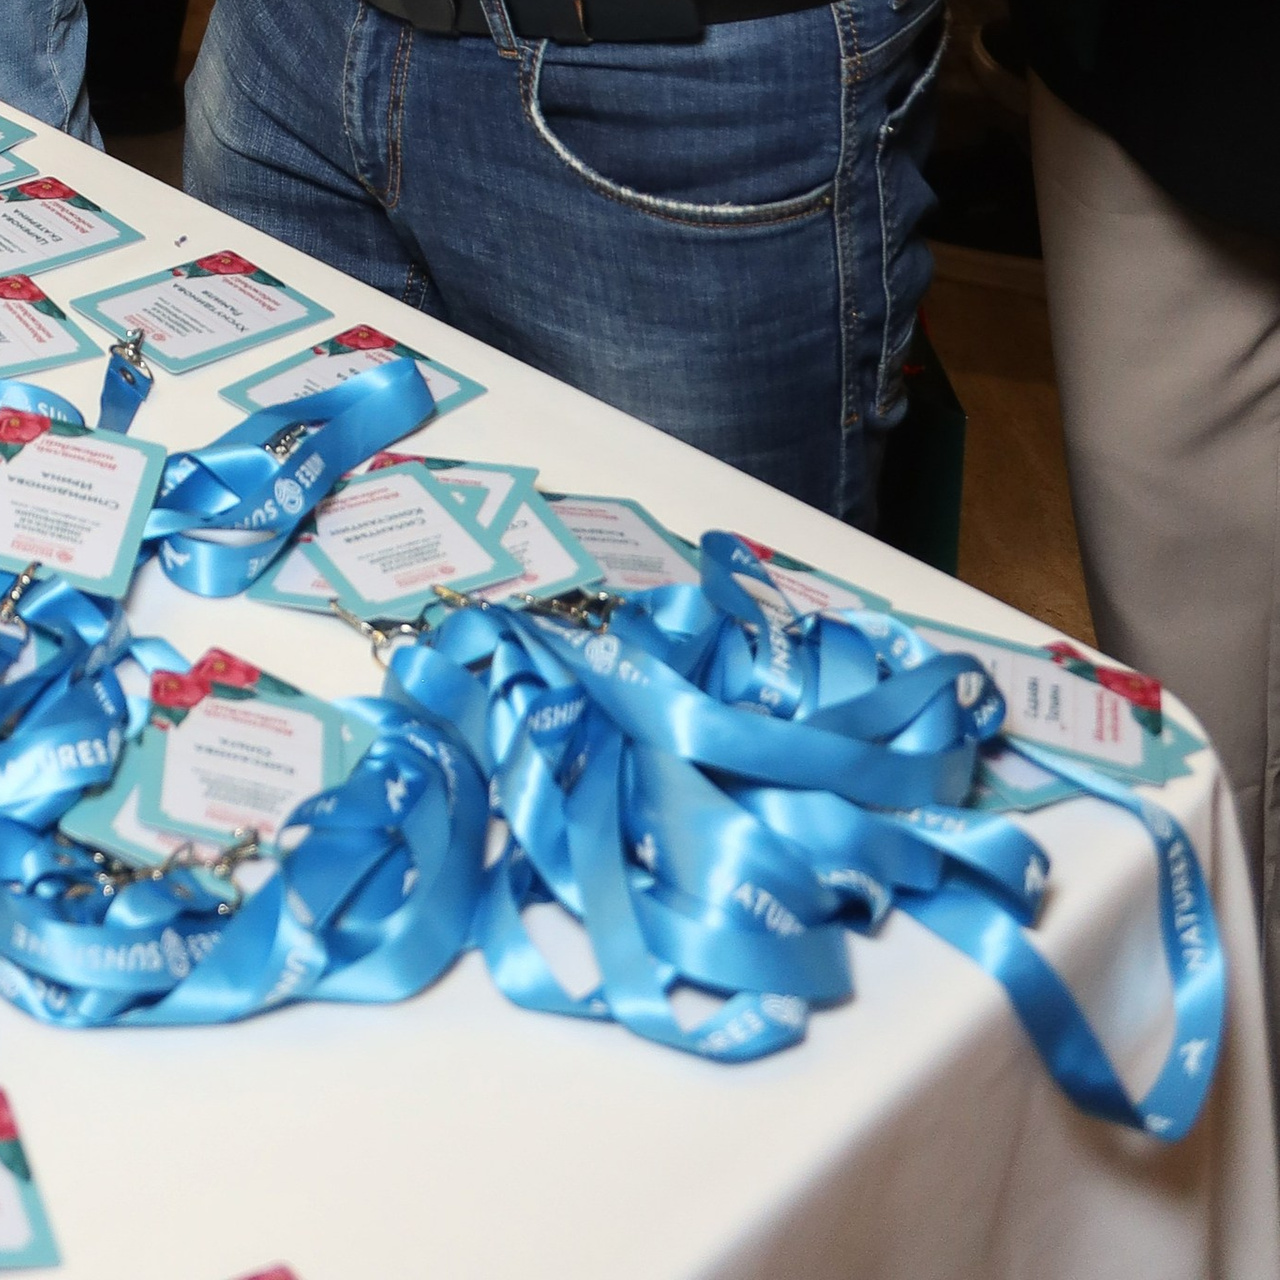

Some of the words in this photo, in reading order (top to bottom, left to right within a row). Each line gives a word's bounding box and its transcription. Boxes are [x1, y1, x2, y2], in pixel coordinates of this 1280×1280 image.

[9, 208, 64, 242] ЕКАТЕРИНА
[4, 474, 121, 511] СПИРИДОНОВА
[39, 470, 93, 491] ИРИНА
